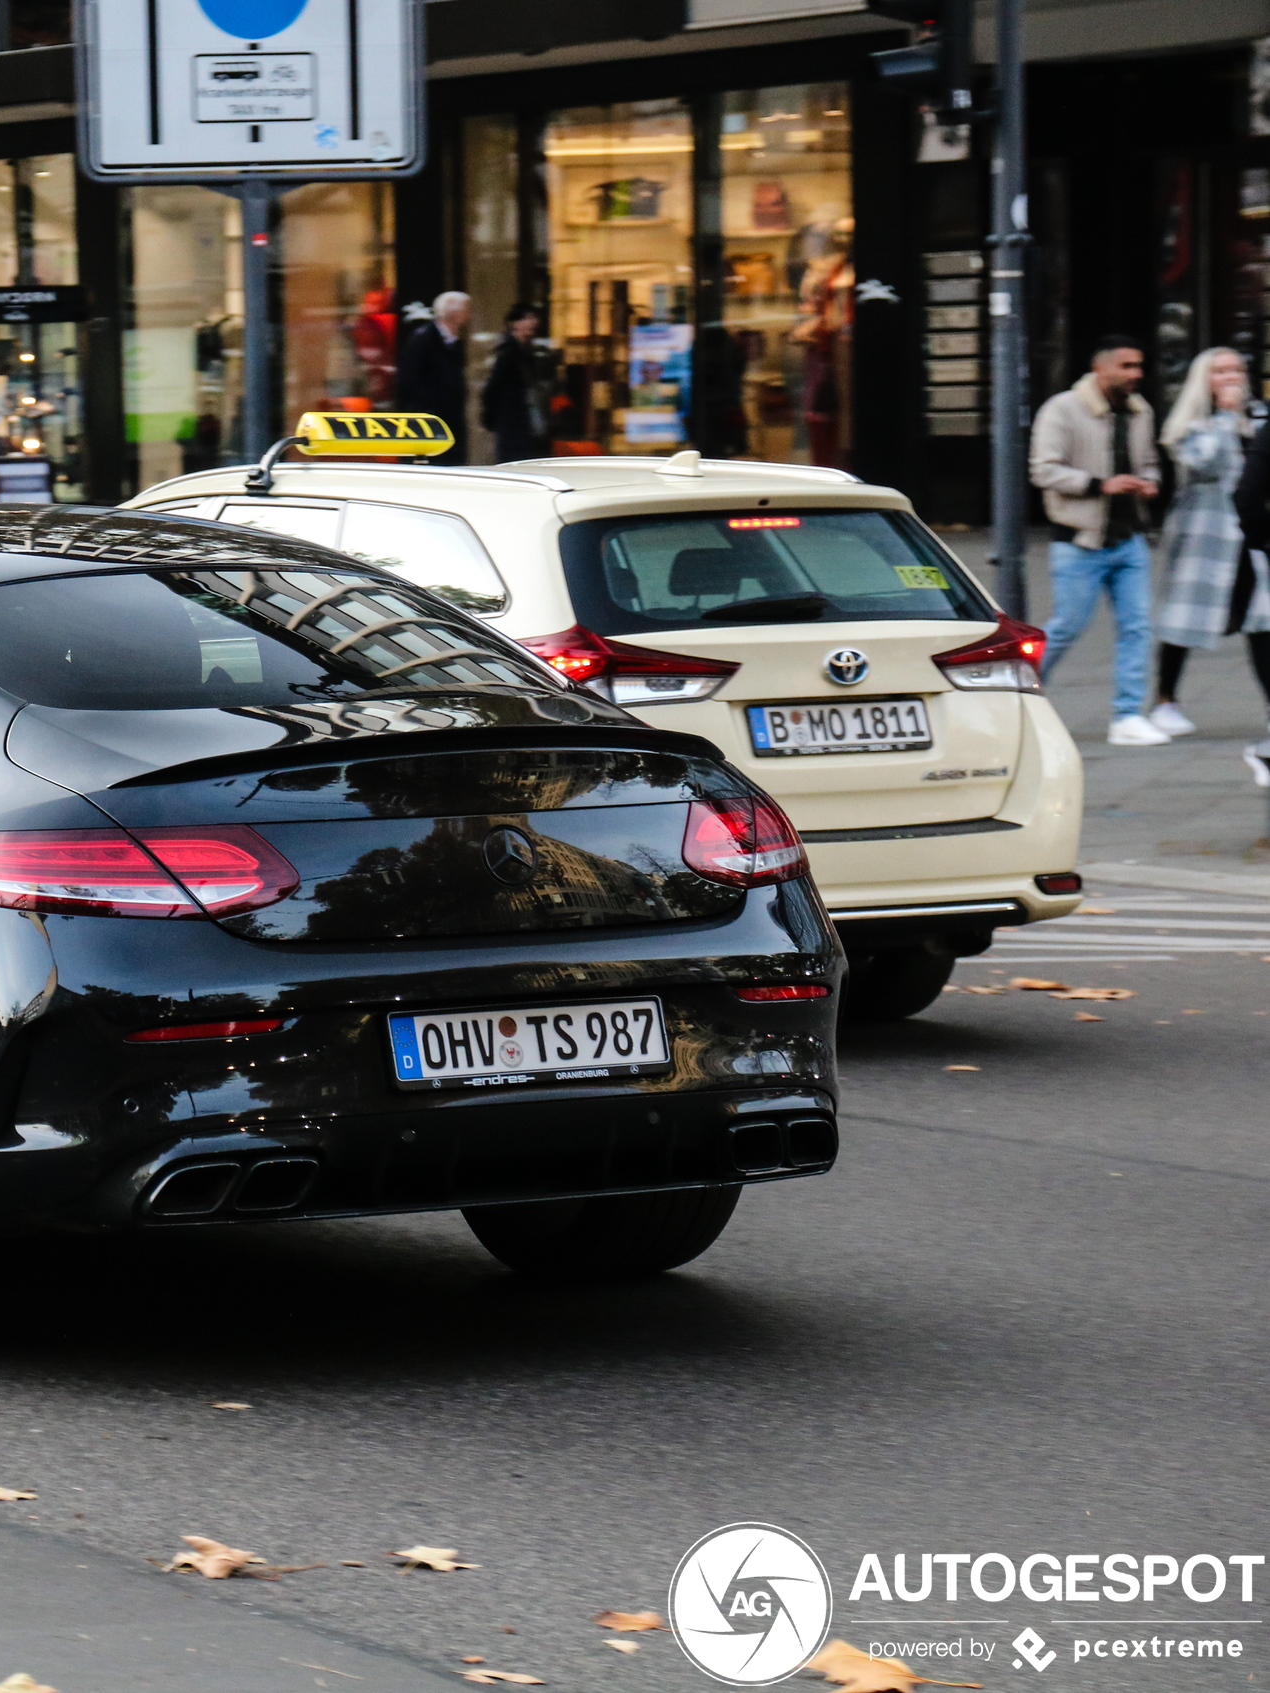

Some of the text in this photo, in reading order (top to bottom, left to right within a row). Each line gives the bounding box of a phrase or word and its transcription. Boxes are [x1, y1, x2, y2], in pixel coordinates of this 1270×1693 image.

[335, 418, 435, 439] TAXI
[768, 711, 790, 744] B
[806, 708, 847, 742] MO
[853, 705, 925, 740] 1811
[403, 1007, 655, 1070] D OHV TS 987
[468, 1068, 610, 1087] endres ORANIENBURG
